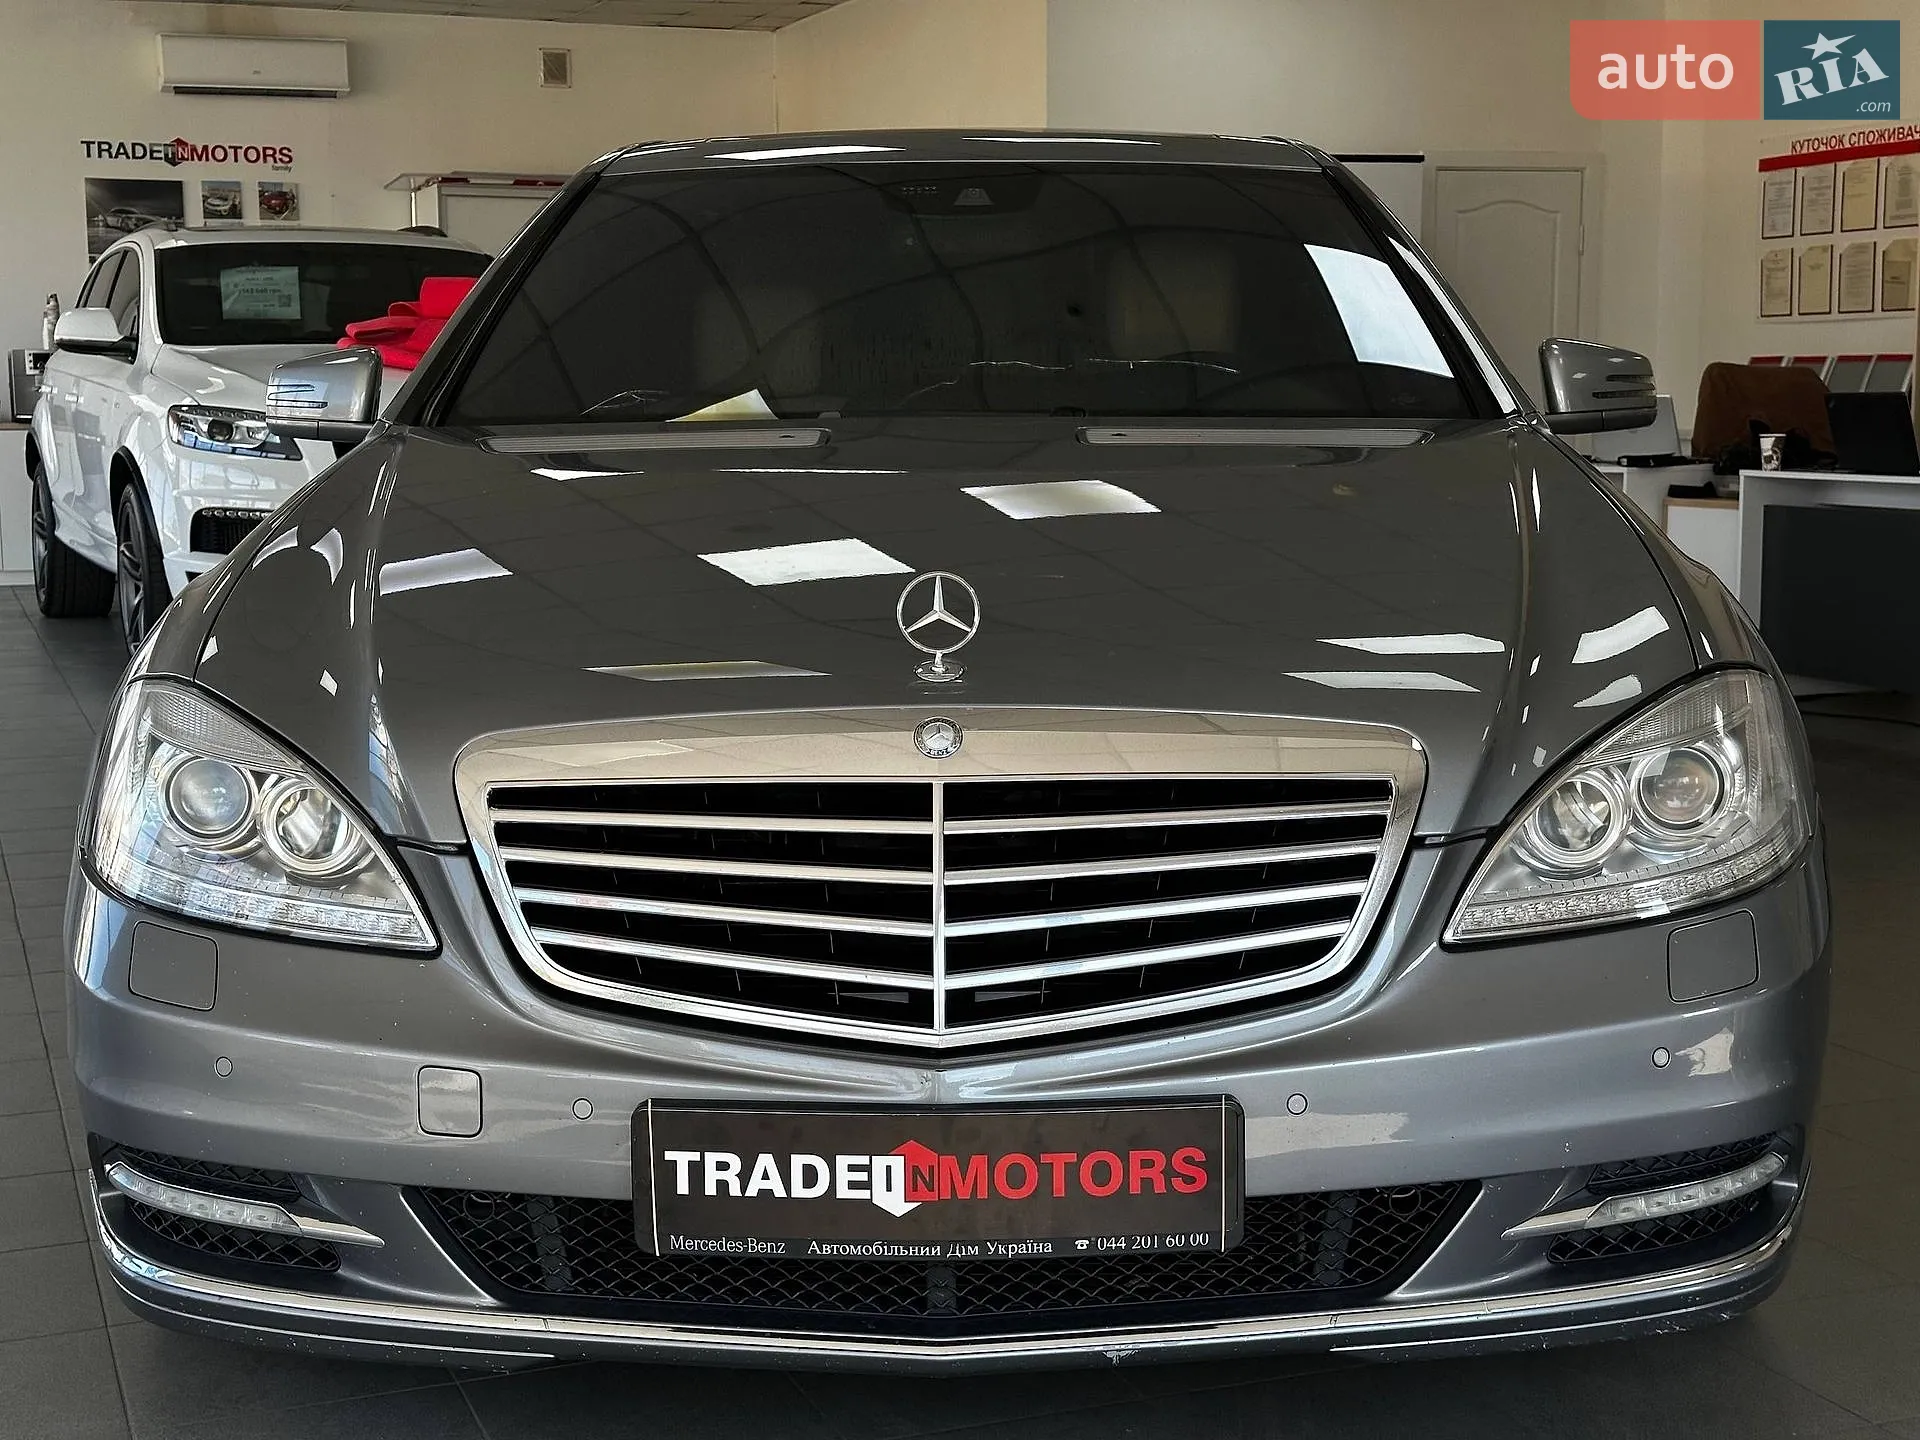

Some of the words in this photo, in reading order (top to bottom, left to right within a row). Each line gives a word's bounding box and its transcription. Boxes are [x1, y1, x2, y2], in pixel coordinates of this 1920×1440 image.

[1791, 134, 1846, 155] КУТОЧОК
[669, 1234, 786, 1255] Mercedes-Benz
[807, 1239, 941, 1257] Автомобільний
[986, 1238, 1053, 1259] Україна
[1096, 1236, 1127, 1251] 044
[1131, 1234, 1159, 1250] 201
[1165, 1233, 1186, 1248] 60
[1189, 1231, 1210, 1247] 00
